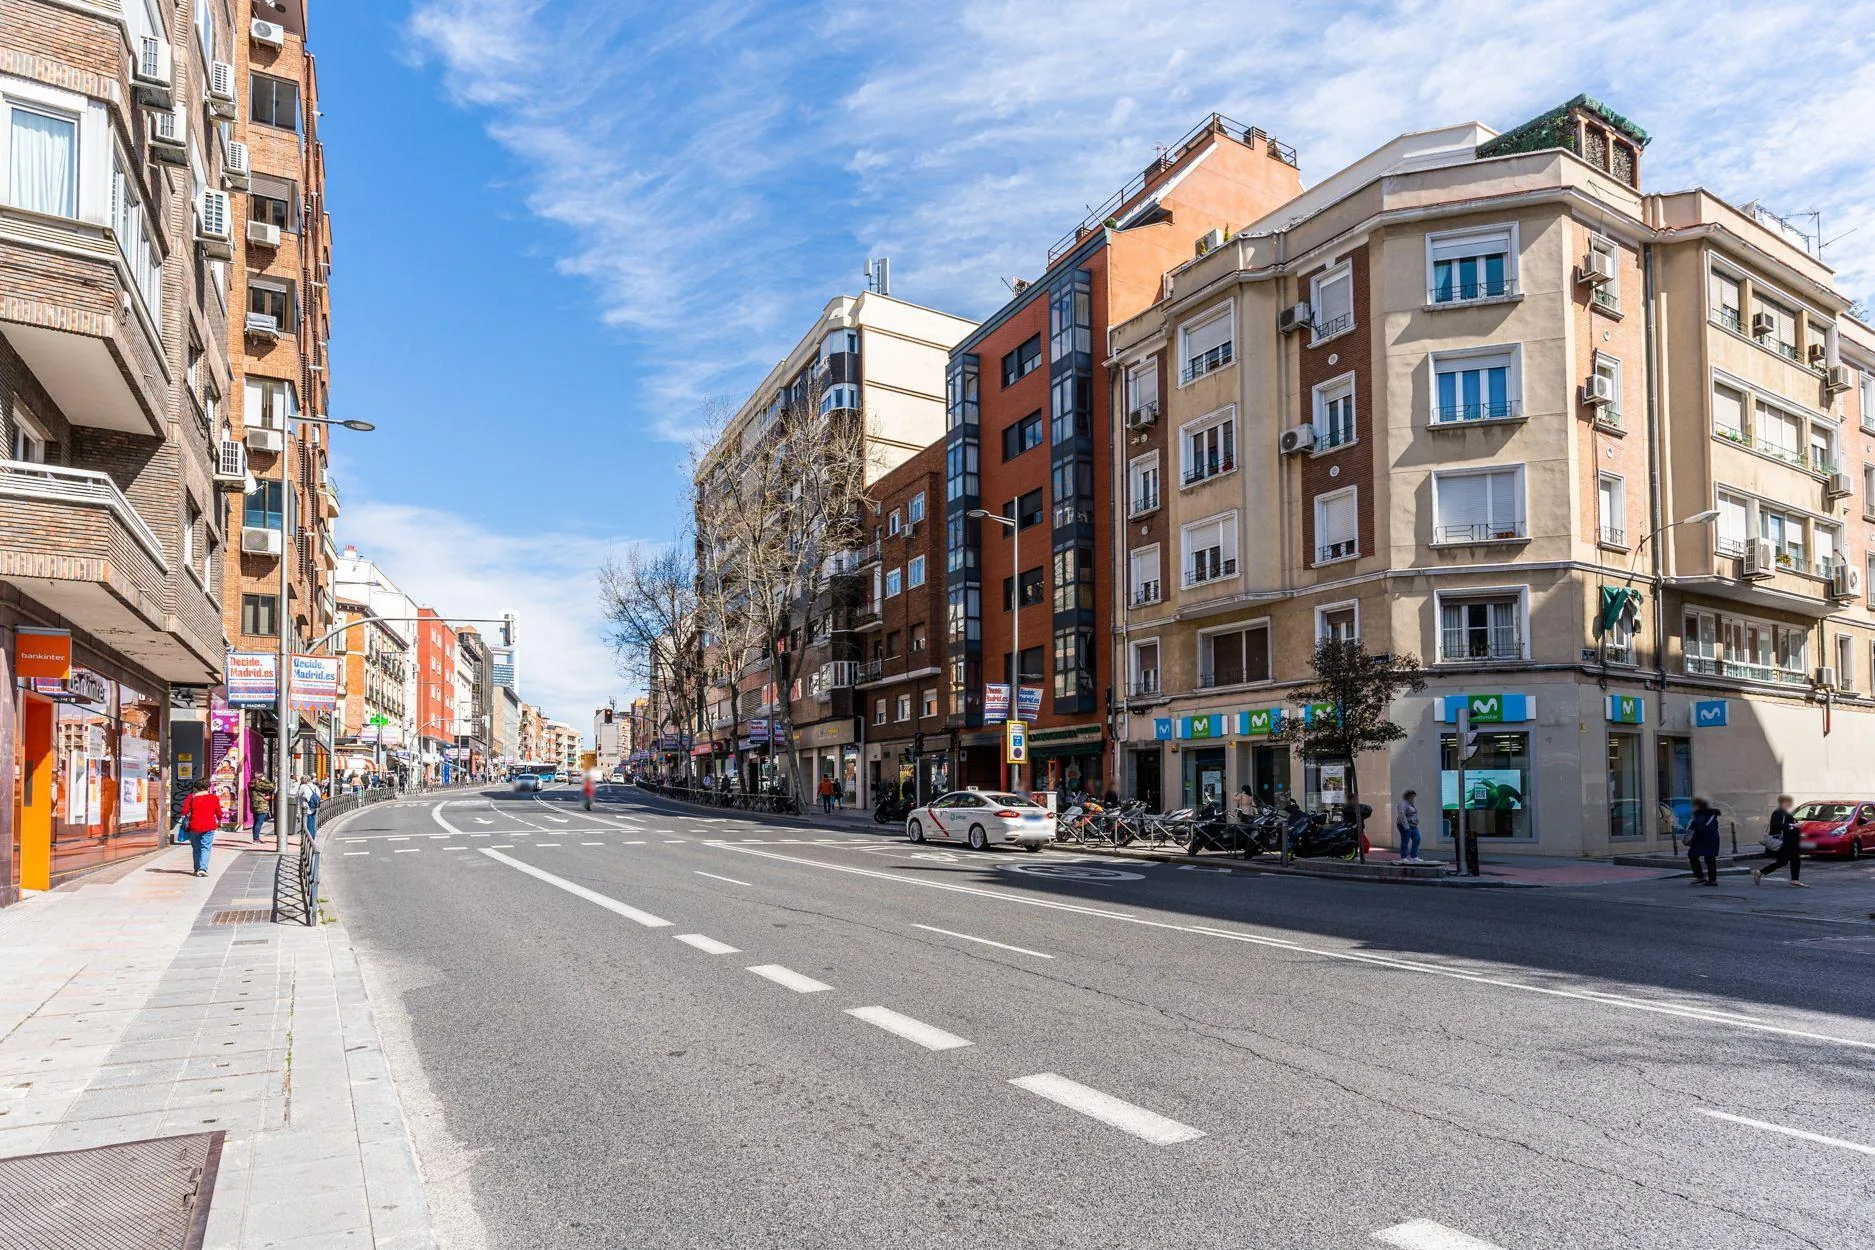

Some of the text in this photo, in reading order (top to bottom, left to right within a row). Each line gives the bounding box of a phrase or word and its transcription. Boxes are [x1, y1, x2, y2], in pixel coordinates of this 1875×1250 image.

[21, 652, 65, 661] bankinter
[230, 656, 263, 667] Decide.
[294, 657, 325, 670] Decide.
[230, 667, 275, 678] Madrid.es
[294, 668, 336, 682] Madrid.es
